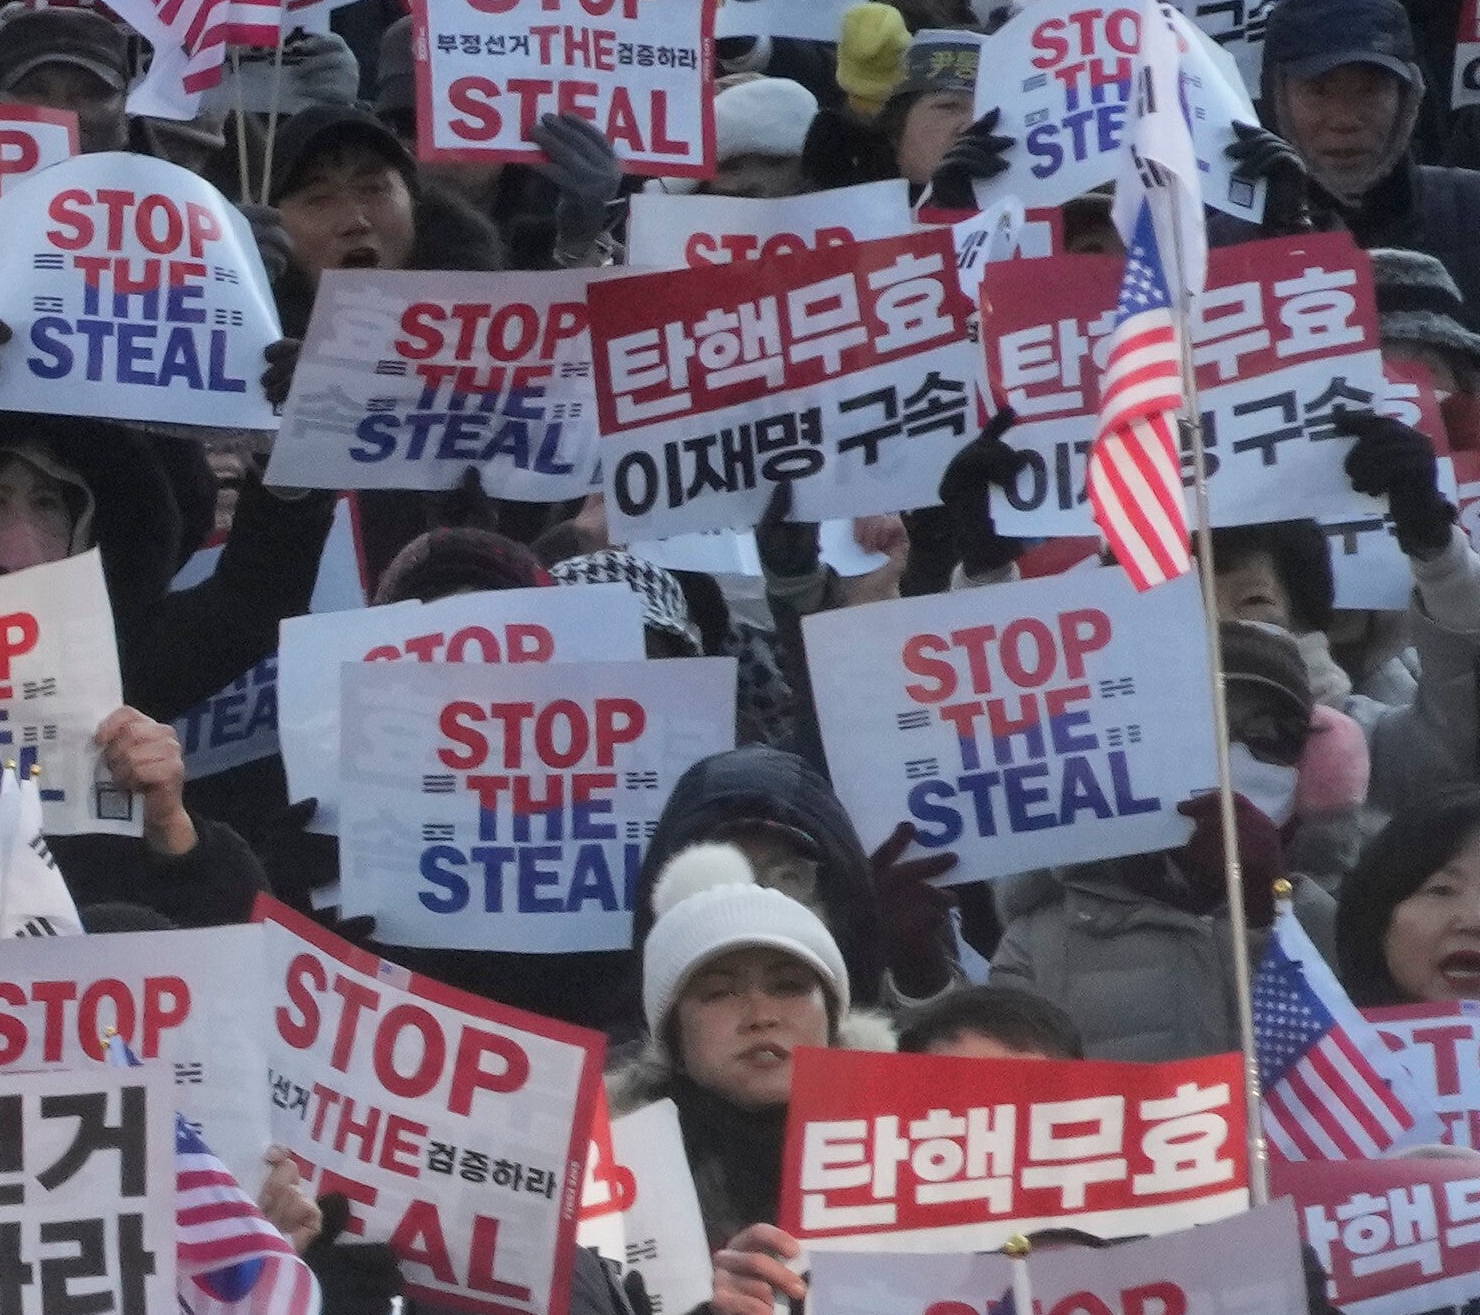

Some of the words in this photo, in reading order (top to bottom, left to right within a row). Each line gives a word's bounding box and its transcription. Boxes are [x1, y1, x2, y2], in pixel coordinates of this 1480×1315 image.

[46, 189, 217, 254] STOP
[74, 256, 208, 323] THE
[27, 318, 245, 393] STEAL
[607, 254, 957, 427] 탄핵무효
[902, 610, 1111, 703] STOP
[437, 697, 646, 769] STOP
[941, 689, 1097, 765] THE
[466, 772, 616, 845] THE
[274, 953, 529, 1117] STOP
[309, 1082, 427, 1179] THE
[800, 1082, 1246, 1230] 탄핵무효
